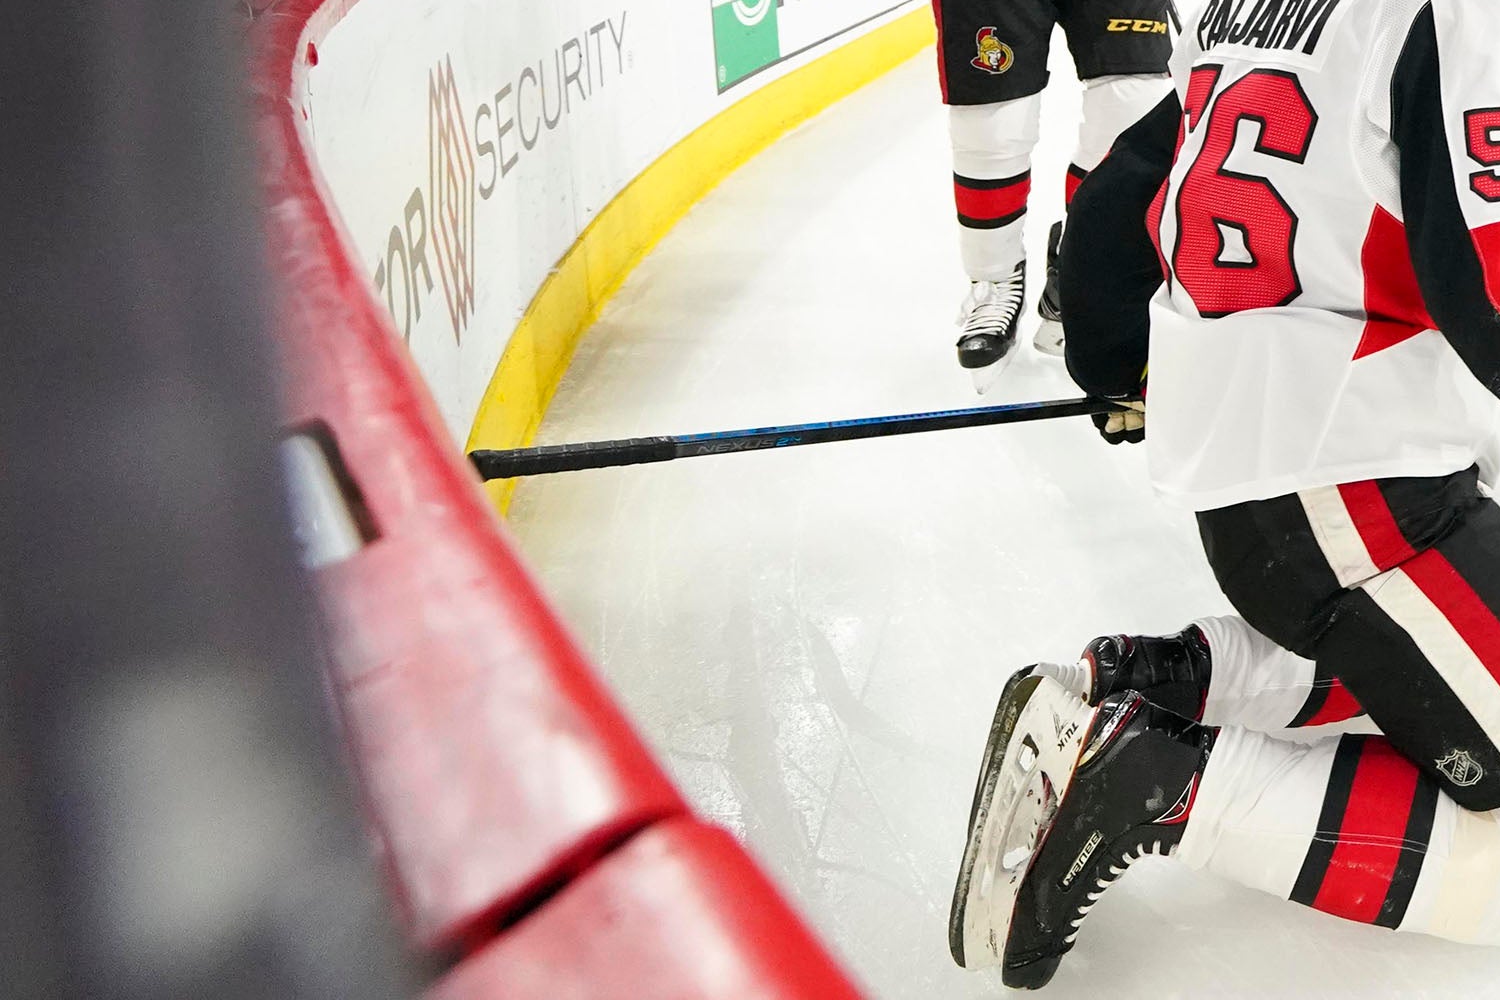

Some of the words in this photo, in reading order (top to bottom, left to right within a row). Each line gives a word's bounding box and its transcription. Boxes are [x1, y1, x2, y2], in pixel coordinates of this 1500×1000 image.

[1106, 18, 1167, 35] CCM
[473, 10, 628, 201] SECURITY
[696, 438, 775, 454] NEXUS
[1062, 830, 1103, 886] BAUER
